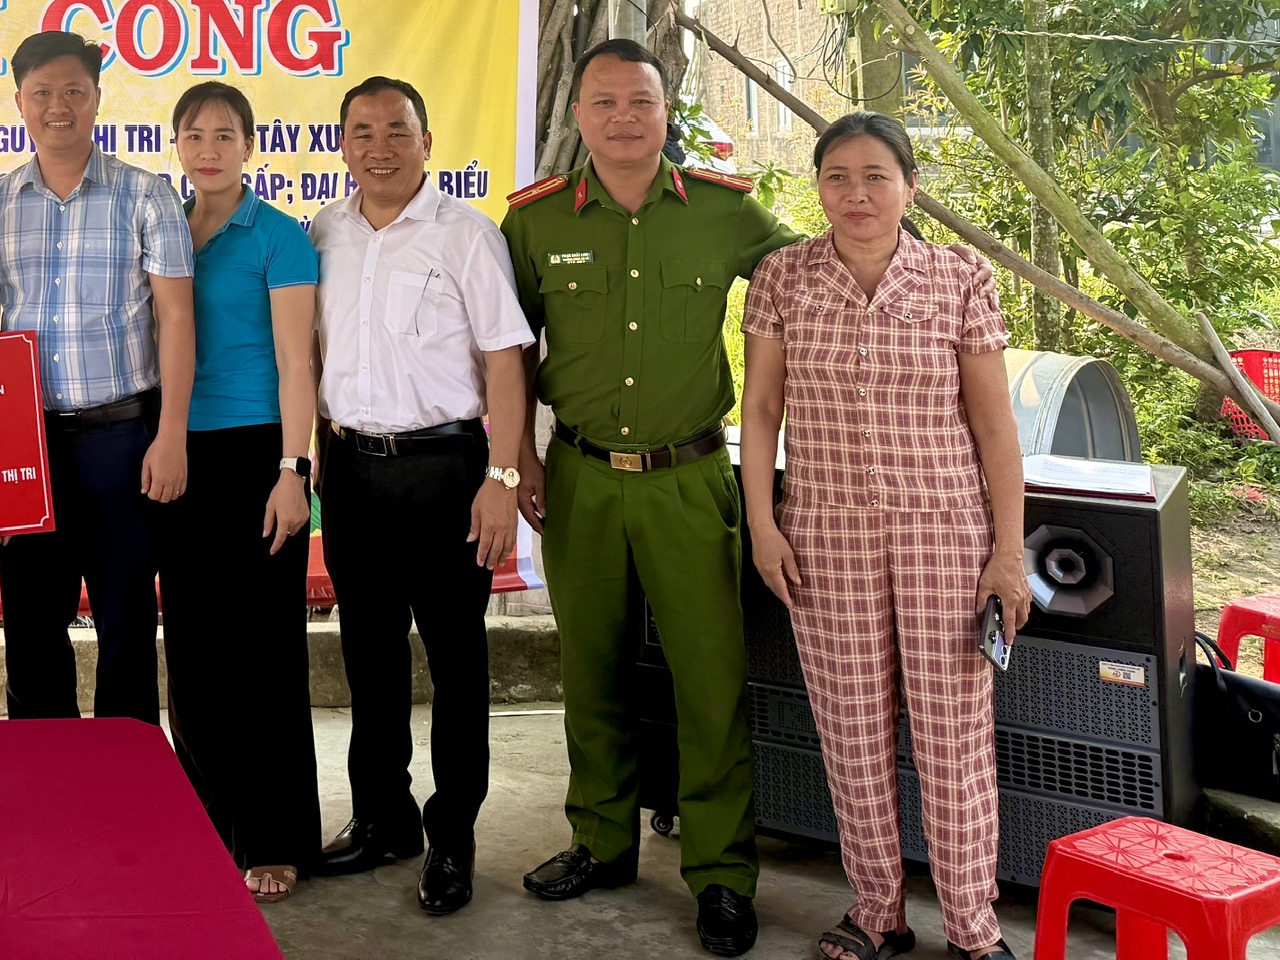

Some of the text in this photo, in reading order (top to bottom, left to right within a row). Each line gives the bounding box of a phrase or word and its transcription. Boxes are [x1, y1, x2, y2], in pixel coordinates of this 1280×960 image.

[124, 124, 161, 153] TRI
[256, 119, 301, 153] TÂY
[308, 124, 341, 153] XU
[301, 172, 339, 206] ĐẠI
[439, 159, 489, 199] BIỂU
[1, 468, 19, 484] THỊ
[20, 466, 37, 481] TRI
